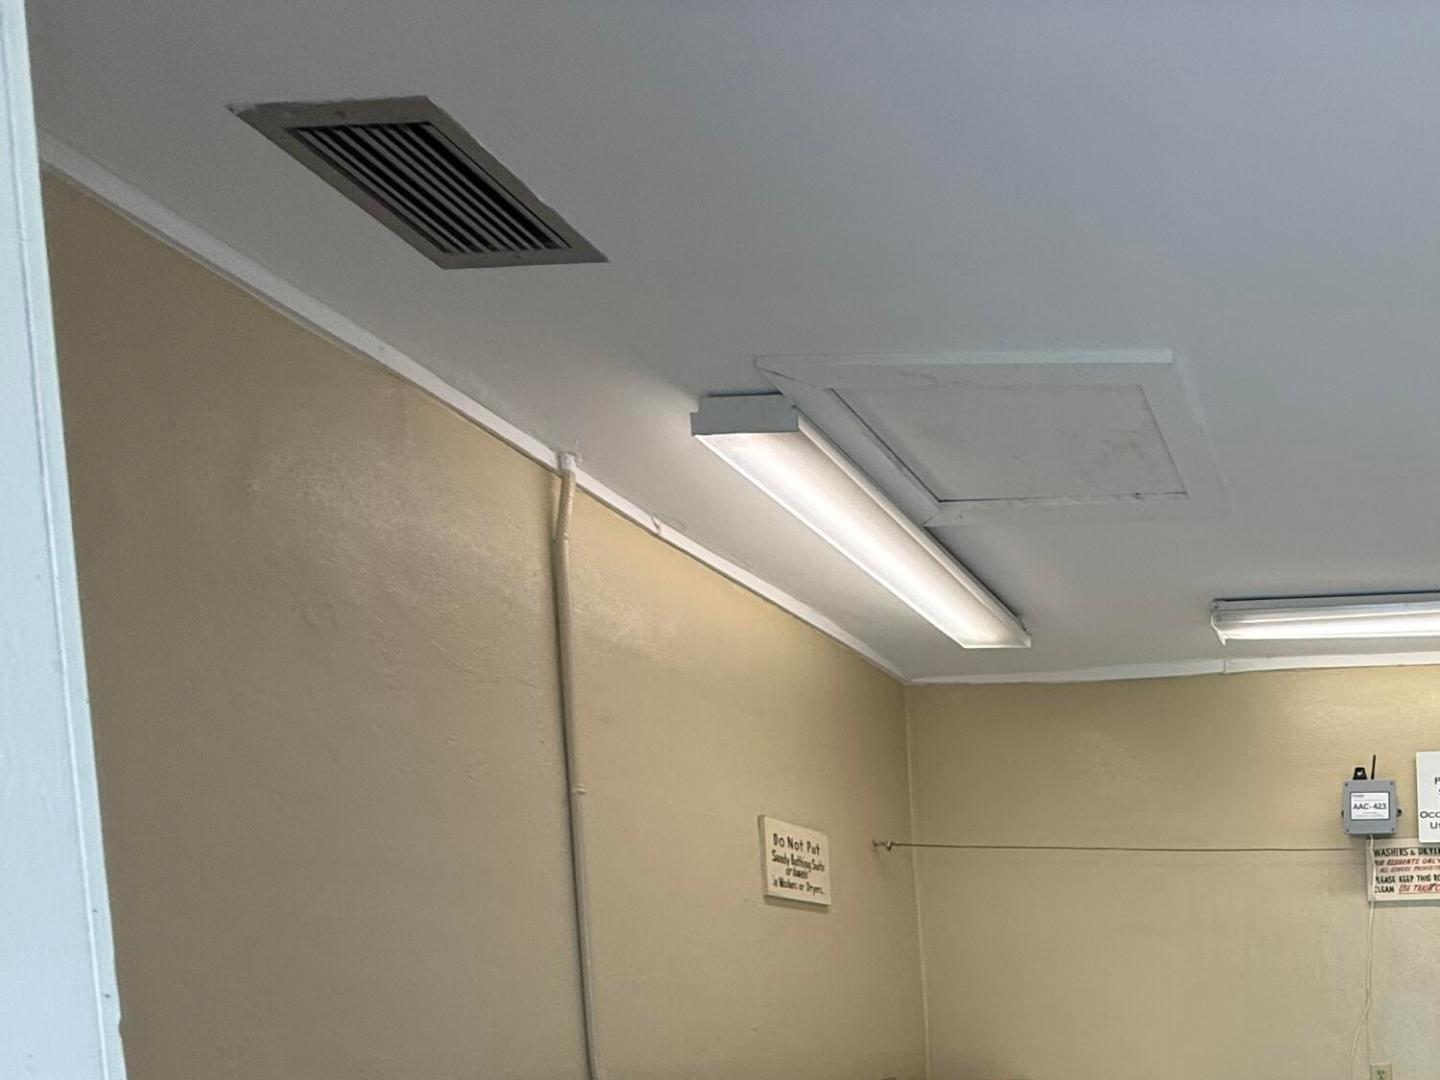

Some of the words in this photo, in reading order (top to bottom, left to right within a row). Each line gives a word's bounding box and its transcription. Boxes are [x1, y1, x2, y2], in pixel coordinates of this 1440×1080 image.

[773, 832, 785, 848] Do
[787, 836, 804, 852] Not
[806, 840, 820, 856] Put
[1373, 847, 1409, 857] WASHERS
[1416, 874, 1432, 882] THIS
